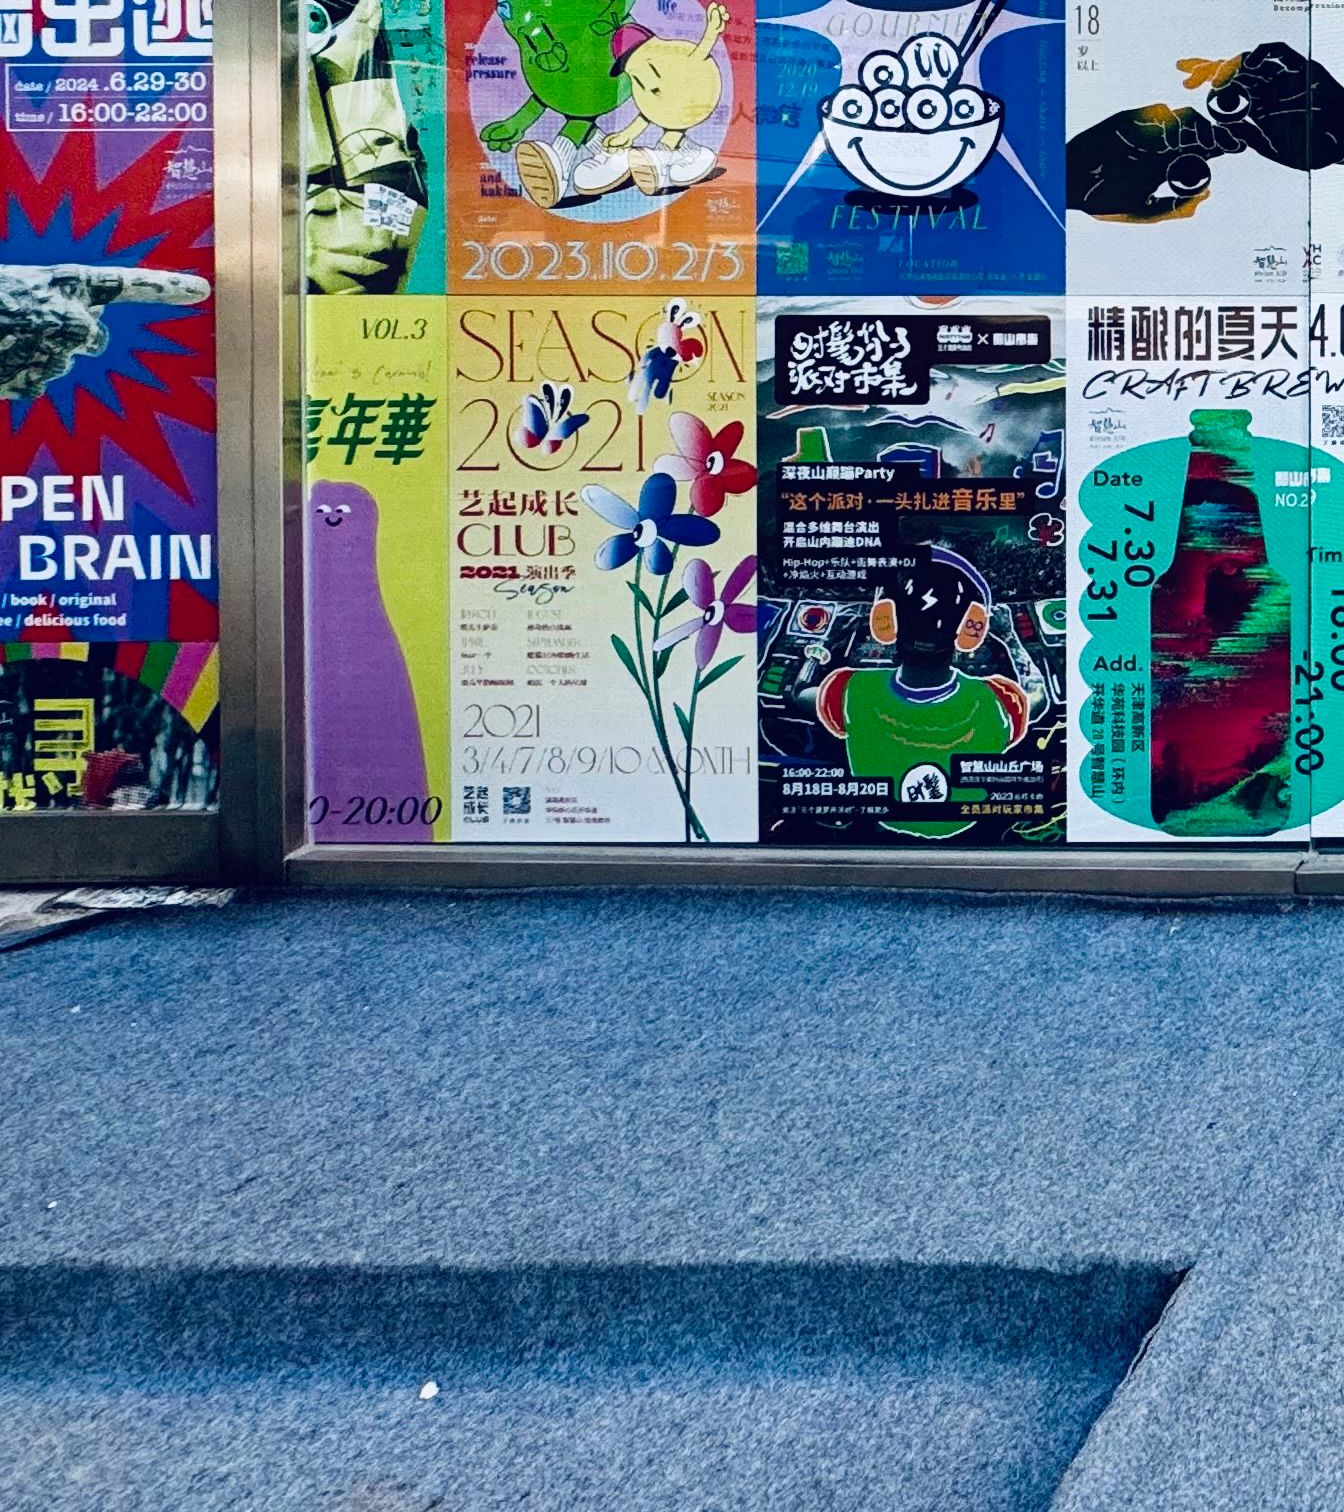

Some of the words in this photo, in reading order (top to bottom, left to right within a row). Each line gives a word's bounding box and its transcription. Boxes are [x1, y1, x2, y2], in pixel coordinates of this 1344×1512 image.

[1074, 4, 1100, 35] 18
[59, 103, 207, 121] 16:00-22:00
[830, 205, 987, 230] FESTIVAL
[462, 241, 744, 280] 2023.10.2/3
[361, 319, 427, 339] VOL.3
[1088, 305, 1298, 361] 精酿的夏天
[457, 310, 747, 382] SEASON
[1094, 470, 1143, 487] Date
[458, 490, 578, 517] 艺起成长
[457, 524, 576, 556] CLUB
[19, 535, 212, 579] BRAIN
[526, 566, 576, 579] 演出季
[59, 594, 116, 608] original
[1094, 654, 1143, 672] Add.
[464, 704, 540, 738] 2021
[783, 768, 844, 778] 16:00-22:00
[783, 782, 888, 797] 8月18日-8月20日
